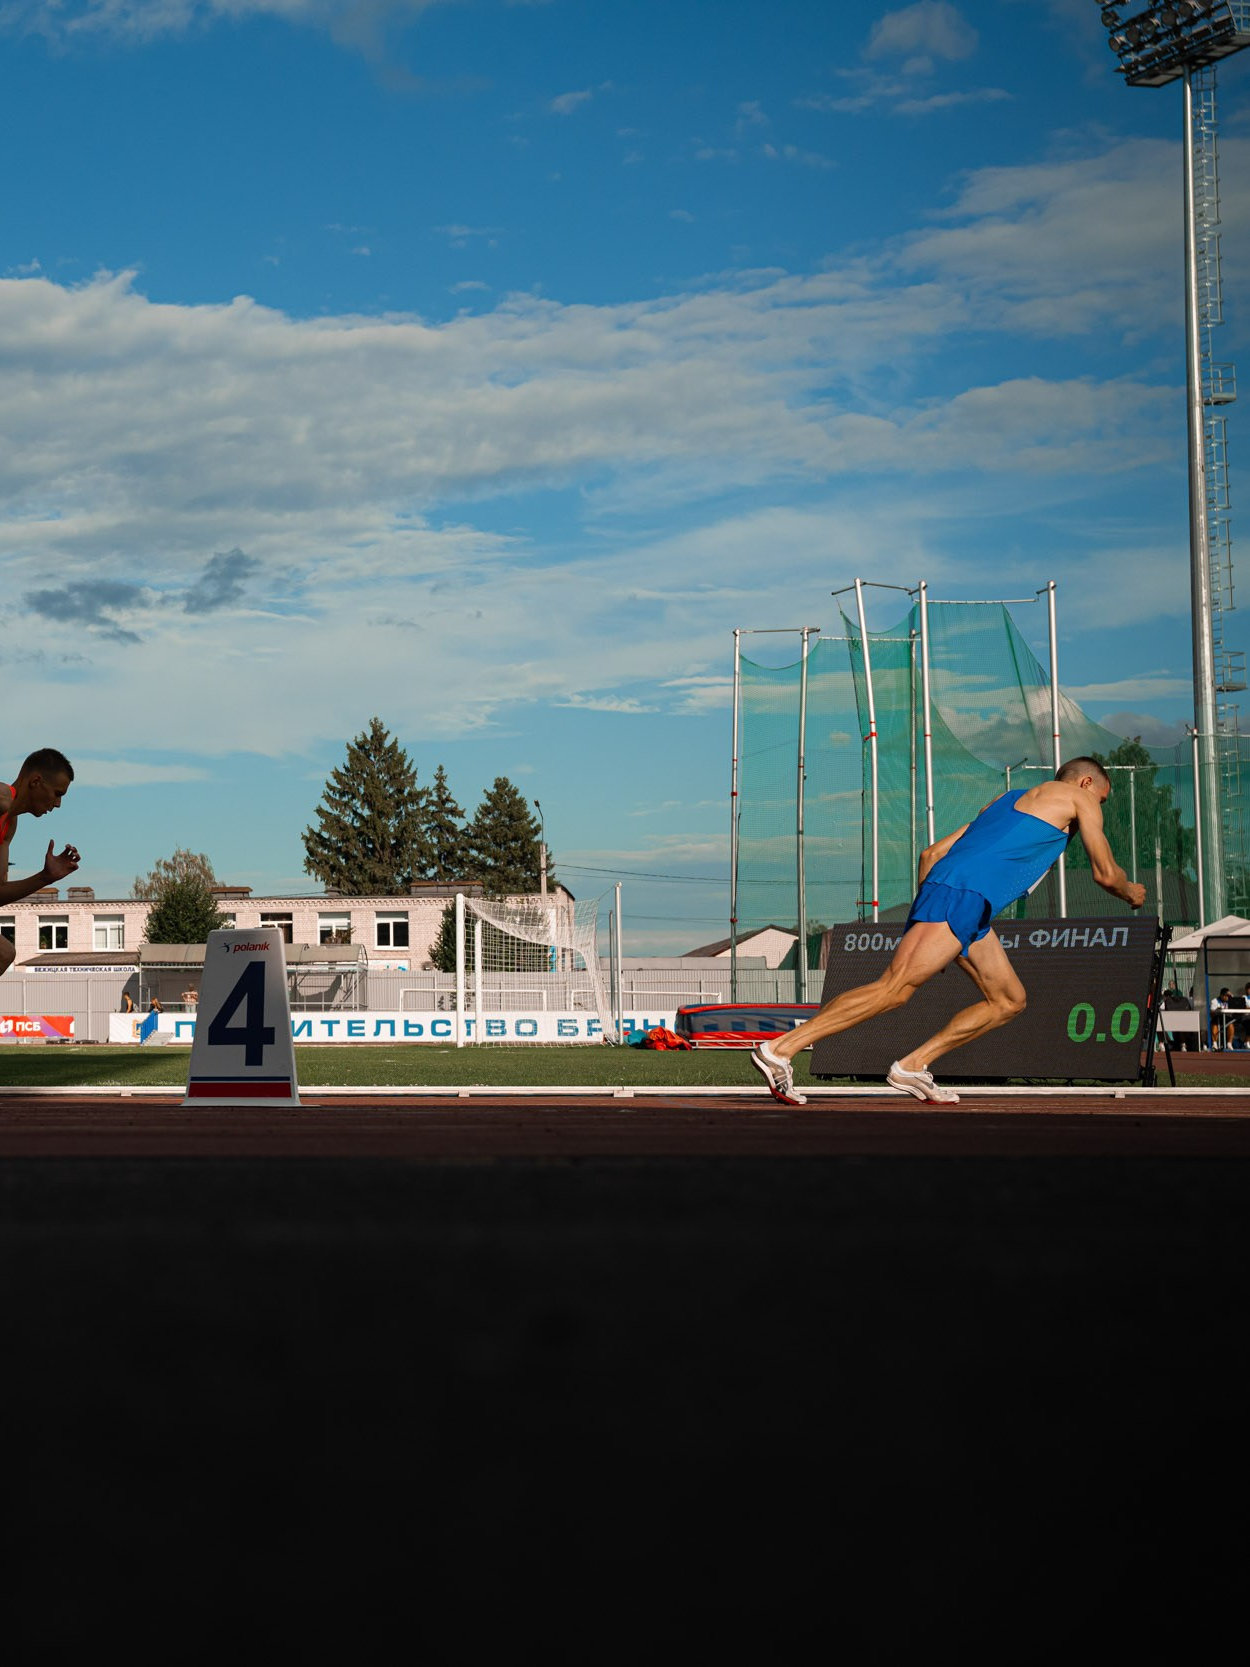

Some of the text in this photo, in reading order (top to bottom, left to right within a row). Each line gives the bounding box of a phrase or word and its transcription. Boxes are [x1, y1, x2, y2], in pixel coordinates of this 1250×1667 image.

[233, 942, 270, 953] polanik
[1028, 926, 1129, 949] ФИНАЛ
[208, 961, 275, 1066] 4
[1066, 1002, 1140, 1043] 0.0
[16, 1021, 41, 1032] ПСБ
